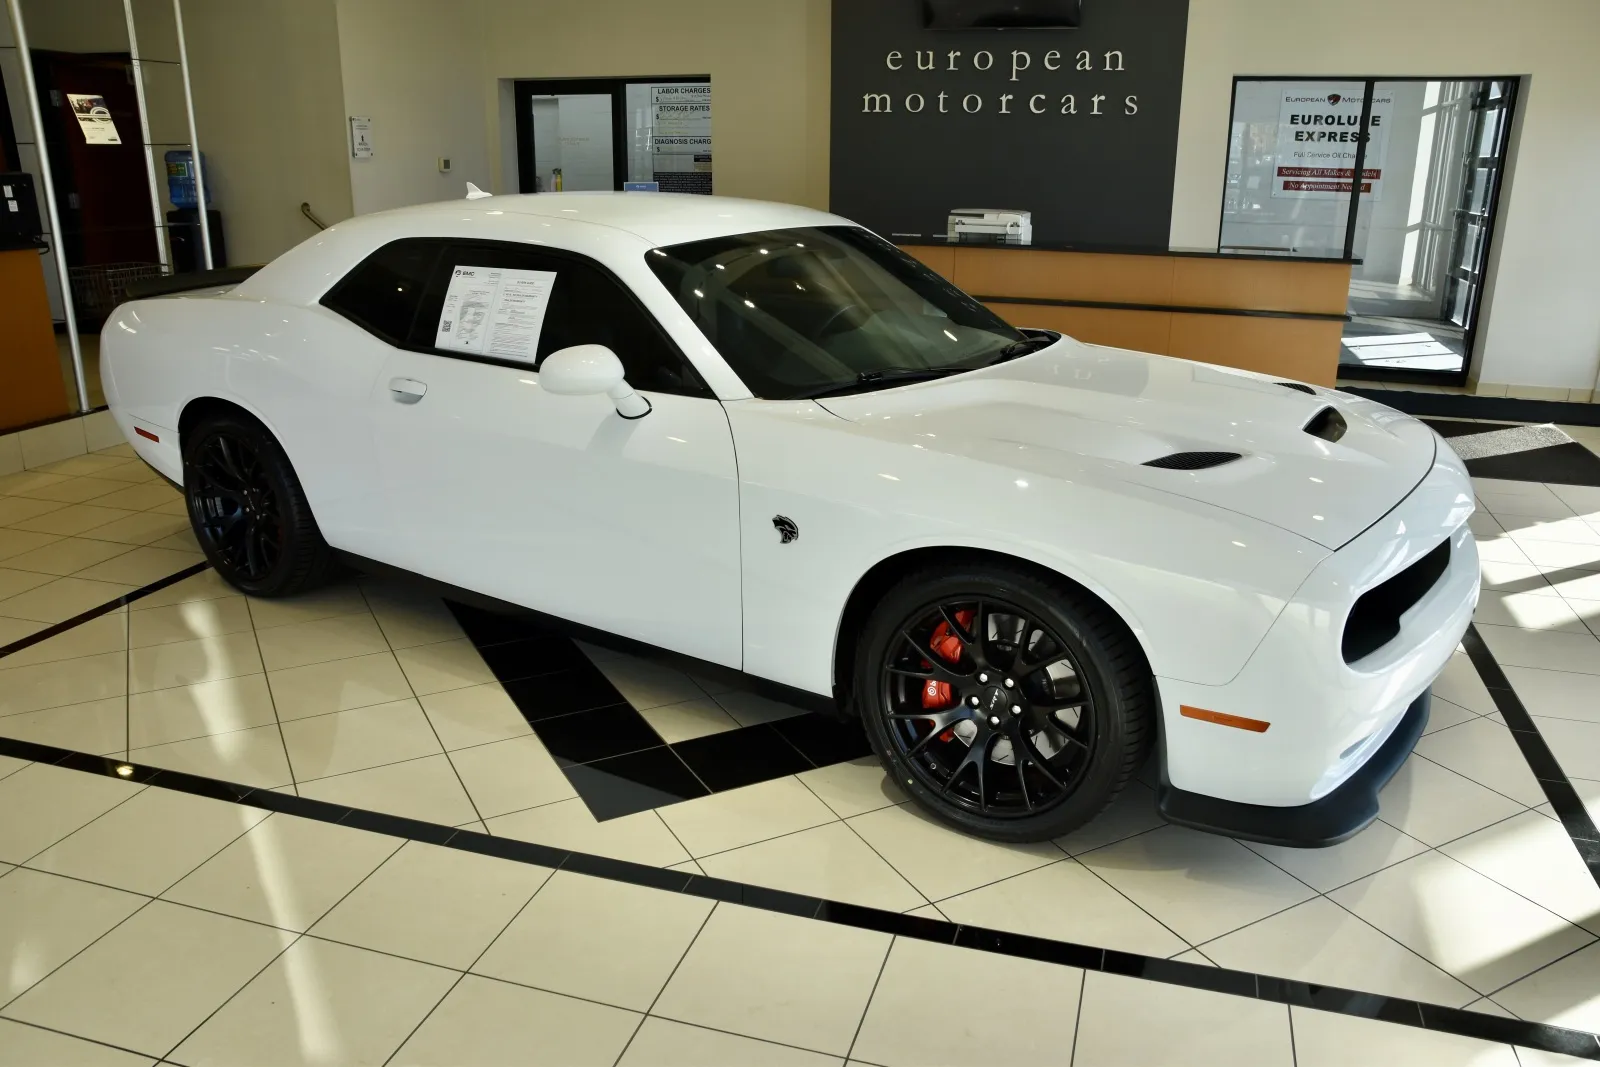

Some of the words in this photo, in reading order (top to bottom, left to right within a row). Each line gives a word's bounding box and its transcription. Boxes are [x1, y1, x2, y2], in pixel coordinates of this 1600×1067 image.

[886, 49, 1125, 81] european
[861, 90, 1138, 115] motorcars
[1290, 114, 1381, 126] EUROLUE
[1281, 168, 1311, 177] Servicing
